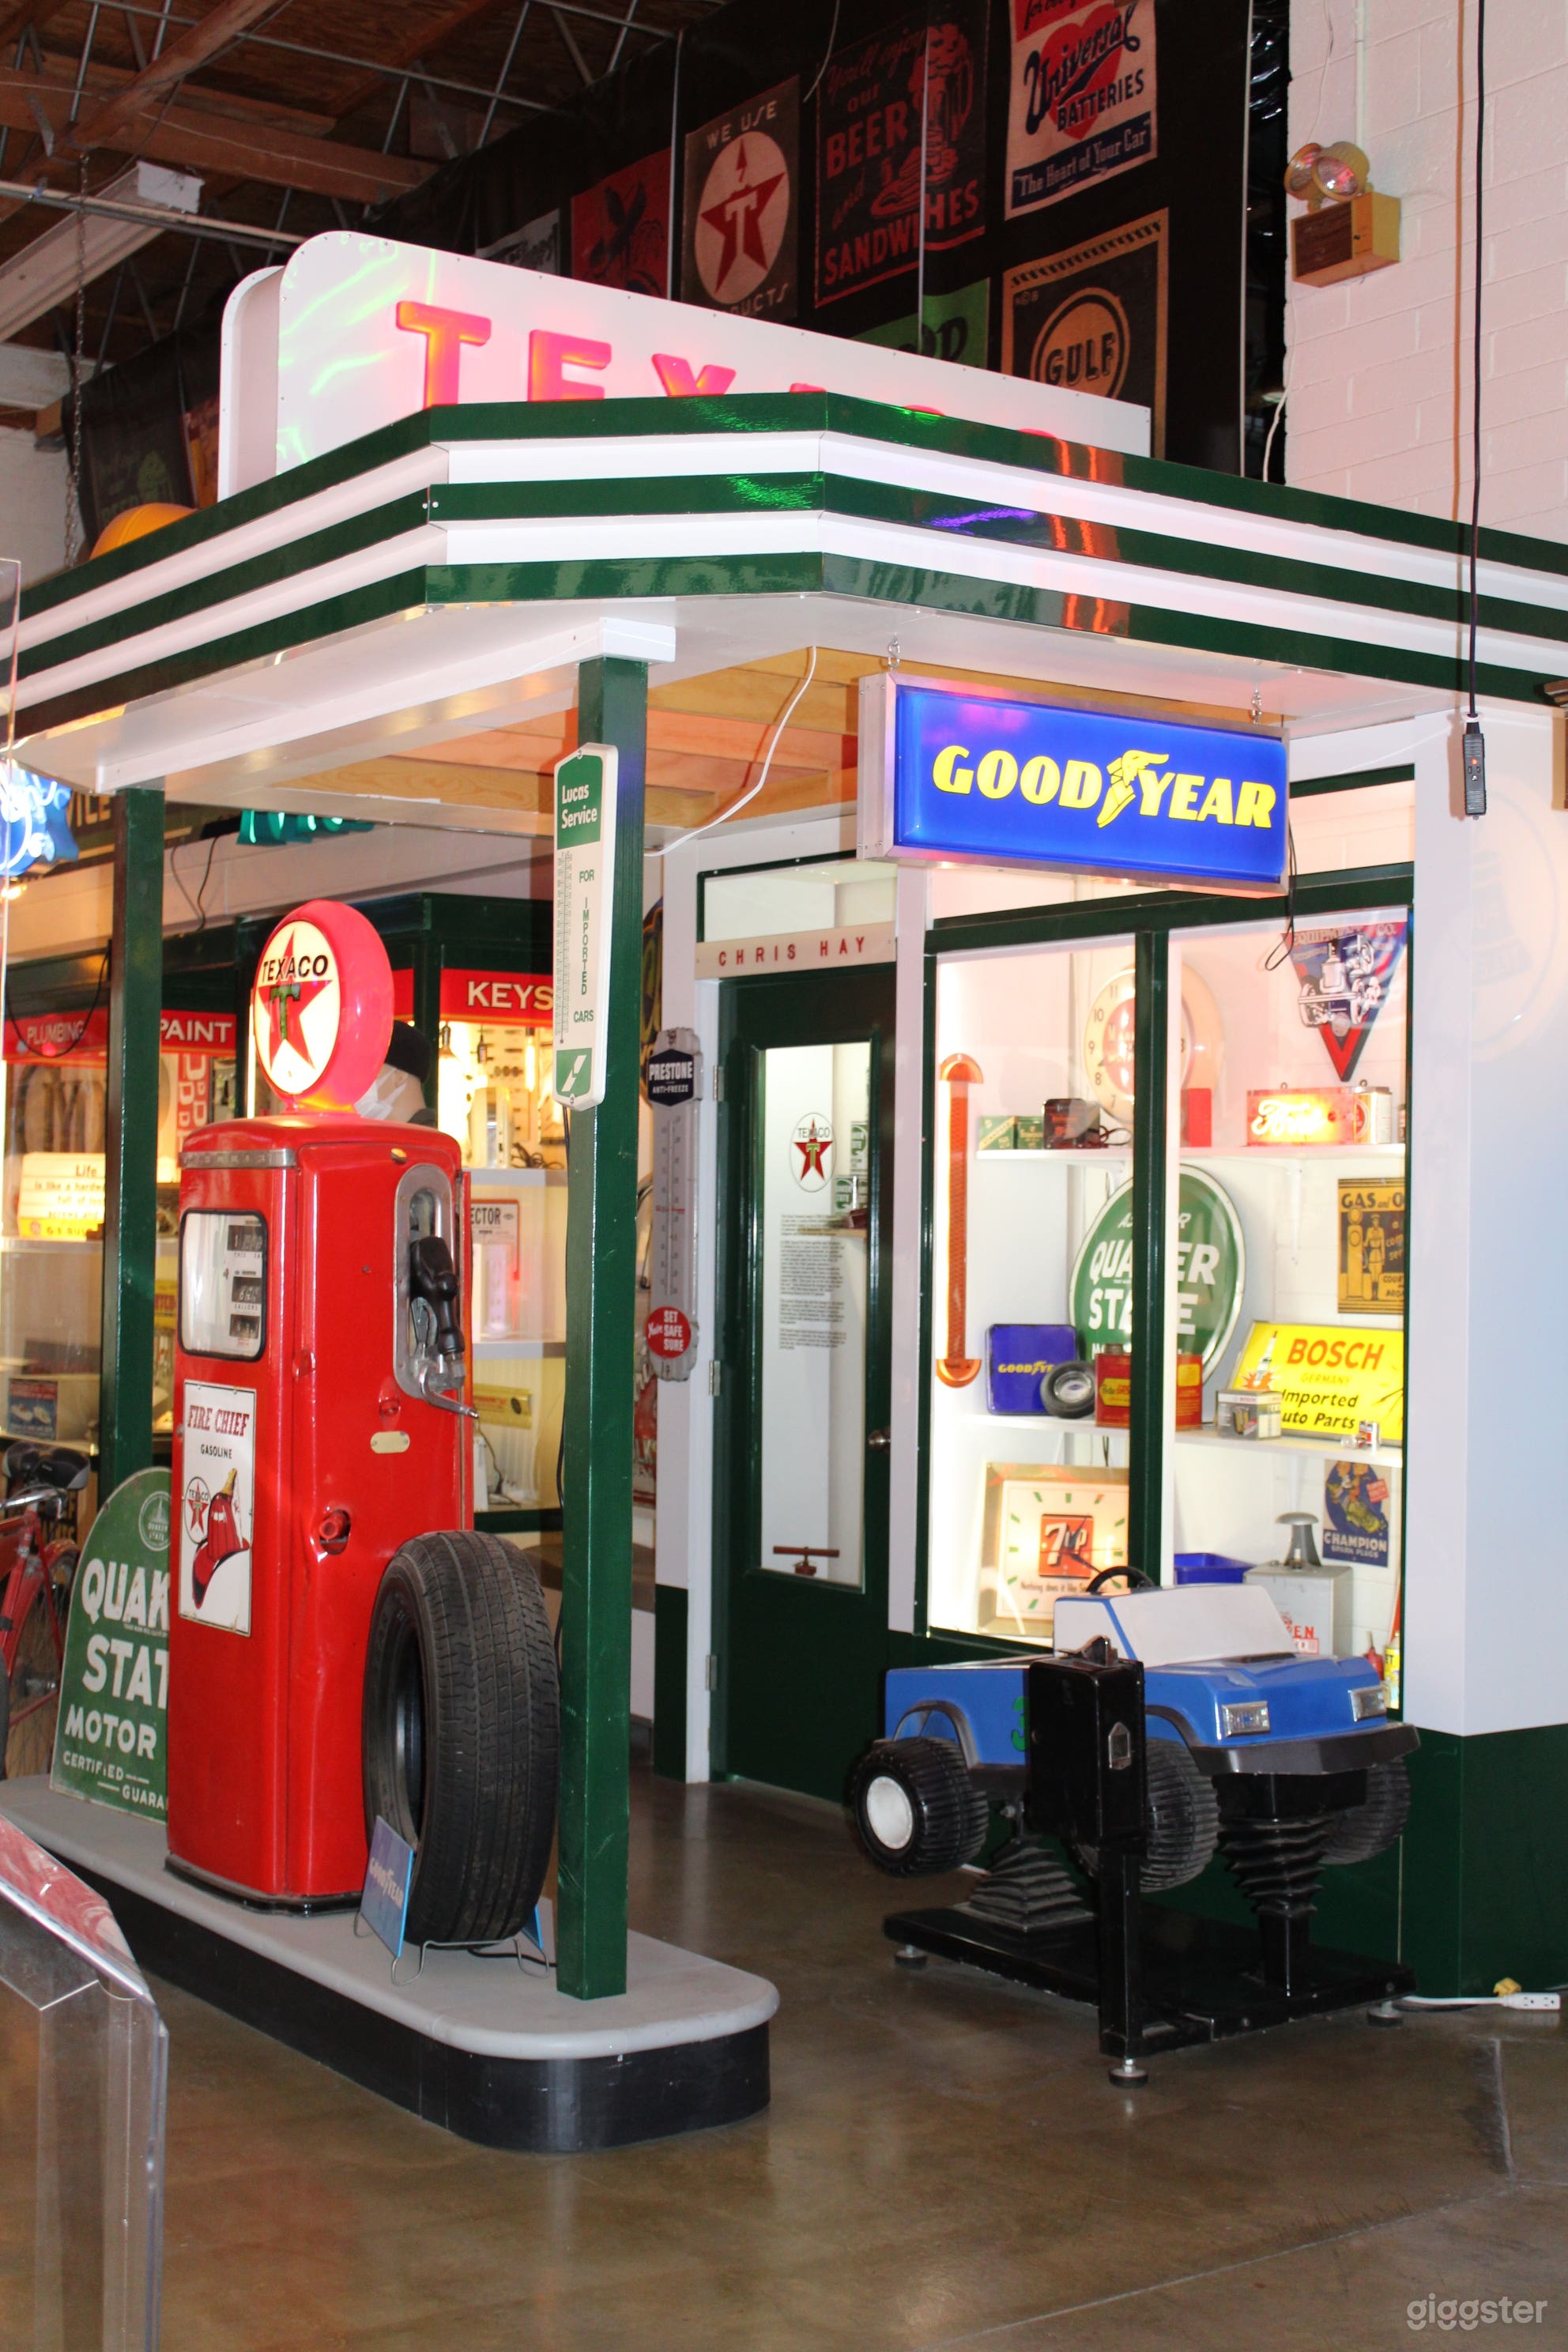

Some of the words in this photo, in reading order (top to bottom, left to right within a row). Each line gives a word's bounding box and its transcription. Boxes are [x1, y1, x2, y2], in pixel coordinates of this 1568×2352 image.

[1023, 1, 1140, 135] Universal
[1057, 68, 1144, 131] BATTERIES
[706, 122, 733, 150] WE
[826, 101, 908, 179] BEER
[1046, 159, 1076, 187] Heart
[1078, 146, 1091, 172] of
[1092, 139, 1121, 164] Your
[824, 179, 980, 285] SANDWIHES
[1046, 332, 1116, 386] GULF
[561, 784, 590, 805] Lucas
[932, 744, 1277, 828] GOODYEAR
[561, 805, 597, 830] Service
[579, 869, 594, 884] FOR
[581, 897, 590, 995] IMPORTED
[718, 944, 796, 967] CHRIS
[820, 937, 865, 957] HAY
[262, 955, 329, 983] TEXACO
[467, 981, 553, 1010] KEYS
[574, 1010, 594, 1023] CARS
[1094, 1008, 1104, 1022] 10
[160, 1019, 232, 1042] PAINT
[1088, 1041, 1095, 1054] 9
[649, 1061, 693, 1080] PRESTONE
[1095, 1072, 1102, 1085] 8
[653, 1084, 689, 1095] ANTI-FREEZE
[1110, 1095, 1117, 1108] 7
[798, 1127, 831, 1138] TEXACO
[76, 1164, 97, 1177] Life
[75, 1181, 104, 1191] hardw
[1341, 1193, 1376, 1209] GAS
[470, 1208, 501, 1225] ECTOR
[1089, 1239, 1220, 1287] QUAER
[664, 1310, 678, 1323] SET
[1088, 1287, 1199, 1336] STAE
[664, 1325, 682, 1338] SAFE
[664, 1338, 684, 1352] SURE
[1287, 1338, 1385, 1370] BOSCH
[1300, 1372, 1352, 1386] GERMANY
[187, 1405, 213, 1432] FIRE
[215, 1408, 250, 1438] CHIEF
[1281, 1411, 1308, 1425] uto
[1314, 1412, 1355, 1429] Parts
[201, 1443, 232, 1460] GASOLINE
[189, 1489, 209, 1502] TEXACO
[1324, 1532, 1387, 1552] CHAMPION
[1332, 1545, 1353, 1555] SPARK
[1355, 1548, 1379, 1559] PLUGS
[81, 1558, 170, 1631] QUAK
[82, 1634, 169, 1709] STAT
[65, 1704, 157, 1760] MOTOR
[62, 1750, 124, 1781] CERTIFIED
[122, 1784, 168, 1811] GUARA
